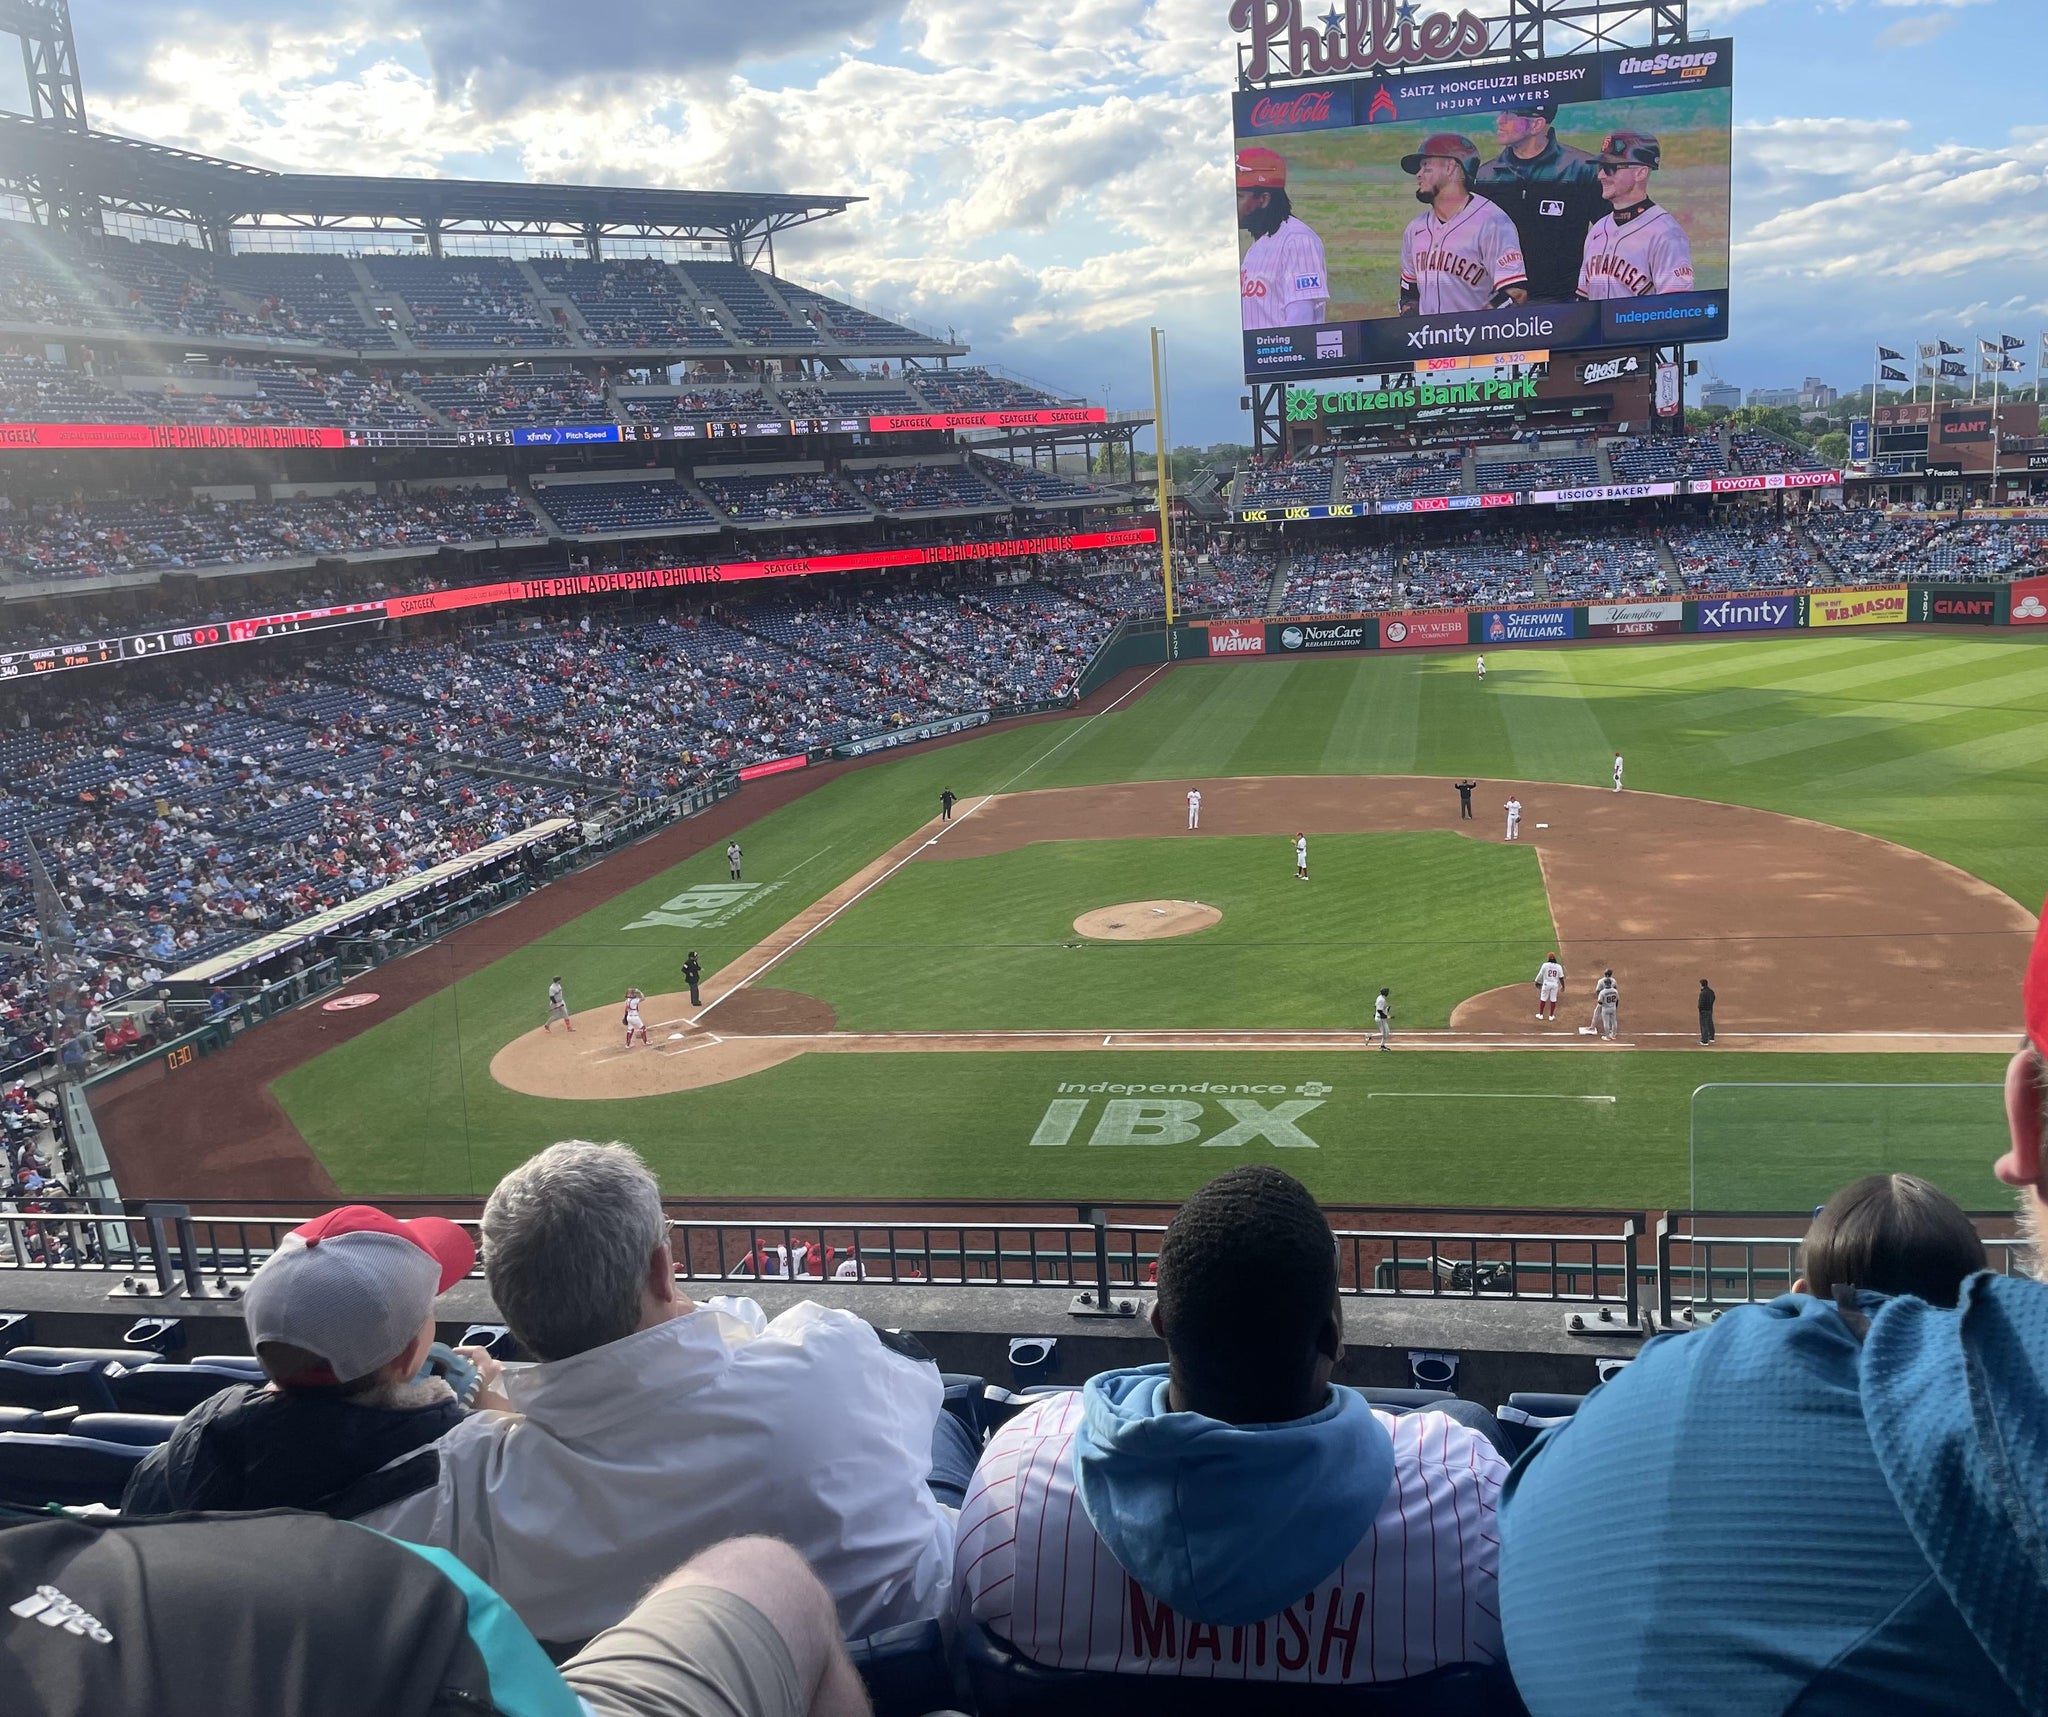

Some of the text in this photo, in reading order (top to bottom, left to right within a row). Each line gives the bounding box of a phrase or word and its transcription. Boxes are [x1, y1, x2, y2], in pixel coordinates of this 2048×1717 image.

[1229, 0, 1488, 81] Phillies
[1619, 51, 1717, 75] theScore
[1682, 67, 1706, 78] BET
[1400, 68, 1586, 98] SALTZ MONGELUZZI BENDESKY
[1436, 89, 1550, 110] INJURY LAWYERS
[1415, 251, 1485, 287] FRANCISCO
[1296, 275, 1320, 290] IBX
[1615, 306, 1701, 324] Independence
[1407, 316, 1553, 349] xfinity mobile
[1256, 335, 1291, 345] Driving
[1256, 345, 1293, 355] smarter
[1257, 354, 1306, 364] outcomes.
[1584, 357, 1627, 385] GHOST
[1322, 374, 1538, 414] Citizens Bank Park
[946, 415, 988, 426] SEATGEEK
[999, 413, 1038, 424] SEATGEEK
[1051, 411, 1089, 421] SEATGEEK
[889, 417, 932, 429] SEATGEEK
[1945, 421, 1987, 433] GIANT
[148, 427, 322, 448] THE PHILADELPHIA PHILLIES
[460, 435, 466, 443] R
[526, 432, 552, 442] xfinity
[565, 431, 607, 440] Pitch Speed
[1789, 472, 1836, 485] TOYOTA
[1934, 469, 1959, 477] Fanatics
[1714, 478, 1762, 490] TOYOTA
[1557, 485, 1650, 500] LISCIO'S BAKERY
[1416, 500, 1447, 511] NECA
[1483, 495, 1514, 506] NECA
[1242, 511, 1267, 522] UKG
[1284, 508, 1310, 519] UKG
[1328, 505, 1353, 516] UKG
[1105, 532, 1142, 544] SEATGEEK
[921, 547, 942, 563] THE
[946, 540, 1025, 562] PHILADELPHIA
[1028, 536, 1074, 553] PHILLIES
[763, 561, 811, 575] SEATGEEK
[522, 580, 550, 599] THE
[553, 571, 662, 596] PHILADELPHIA
[662, 566, 721, 587] PHILLIES
[400, 596, 436, 613] SEATGEEK
[1934, 600, 1994, 615] GIANT
[1507, 613, 1563, 626] SHERWIN
[1606, 606, 1665, 622] Yuengling
[1703, 600, 1788, 627] xfinity
[1304, 625, 1362, 640] NovaCare
[1431, 622, 1462, 632] WEBB
[1616, 623, 1654, 634] LAGER
[134, 633, 192, 655] 0-1 OUTS
[1212, 635, 1262, 653] Wawa
[1305, 639, 1361, 648] REHABILITATION
[29, 650, 55, 660] DISTANCE
[99, 641, 108, 650] LA
[33, 661, 47, 671] 147
[65, 656, 74, 666] 97
[620, 883, 763, 930] IBX
[1057, 1082, 1287, 1095] Independence
[1029, 1099, 1327, 1148] IBX
